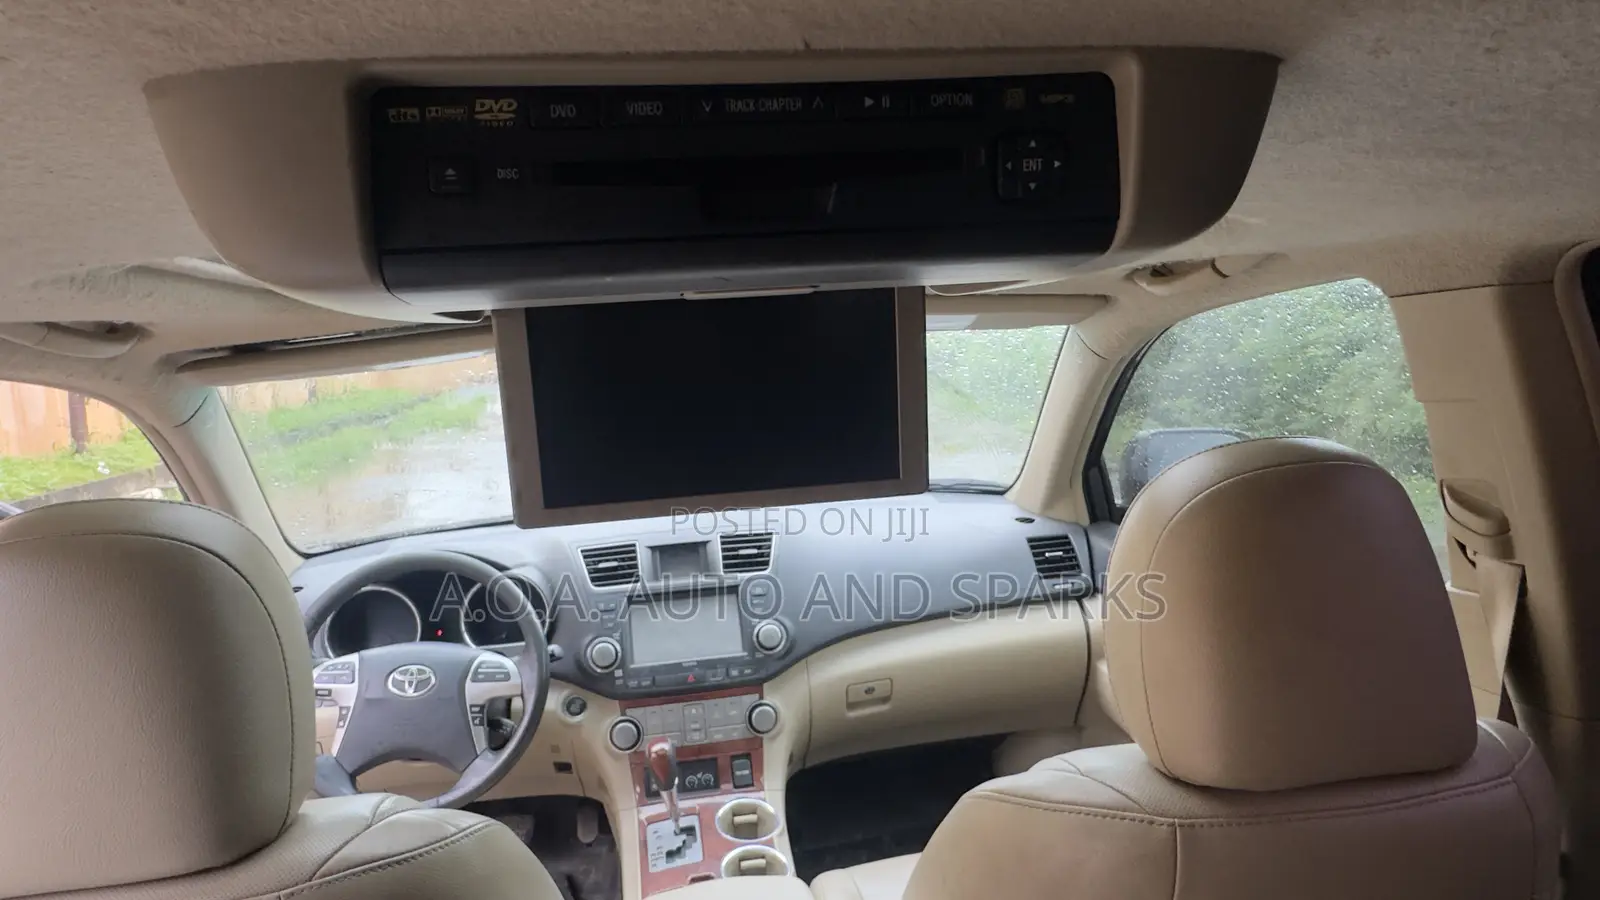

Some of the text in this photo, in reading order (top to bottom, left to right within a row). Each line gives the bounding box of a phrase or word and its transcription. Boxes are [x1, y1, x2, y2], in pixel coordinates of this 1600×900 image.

[475, 98, 518, 113] DVD
[725, 98, 756, 113] TRACK
[931, 93, 974, 108] OPTION
[550, 104, 576, 118] DVD
[625, 101, 663, 116] VIDEO
[1022, 158, 1044, 172] ENT
[497, 167, 519, 180] DISC
